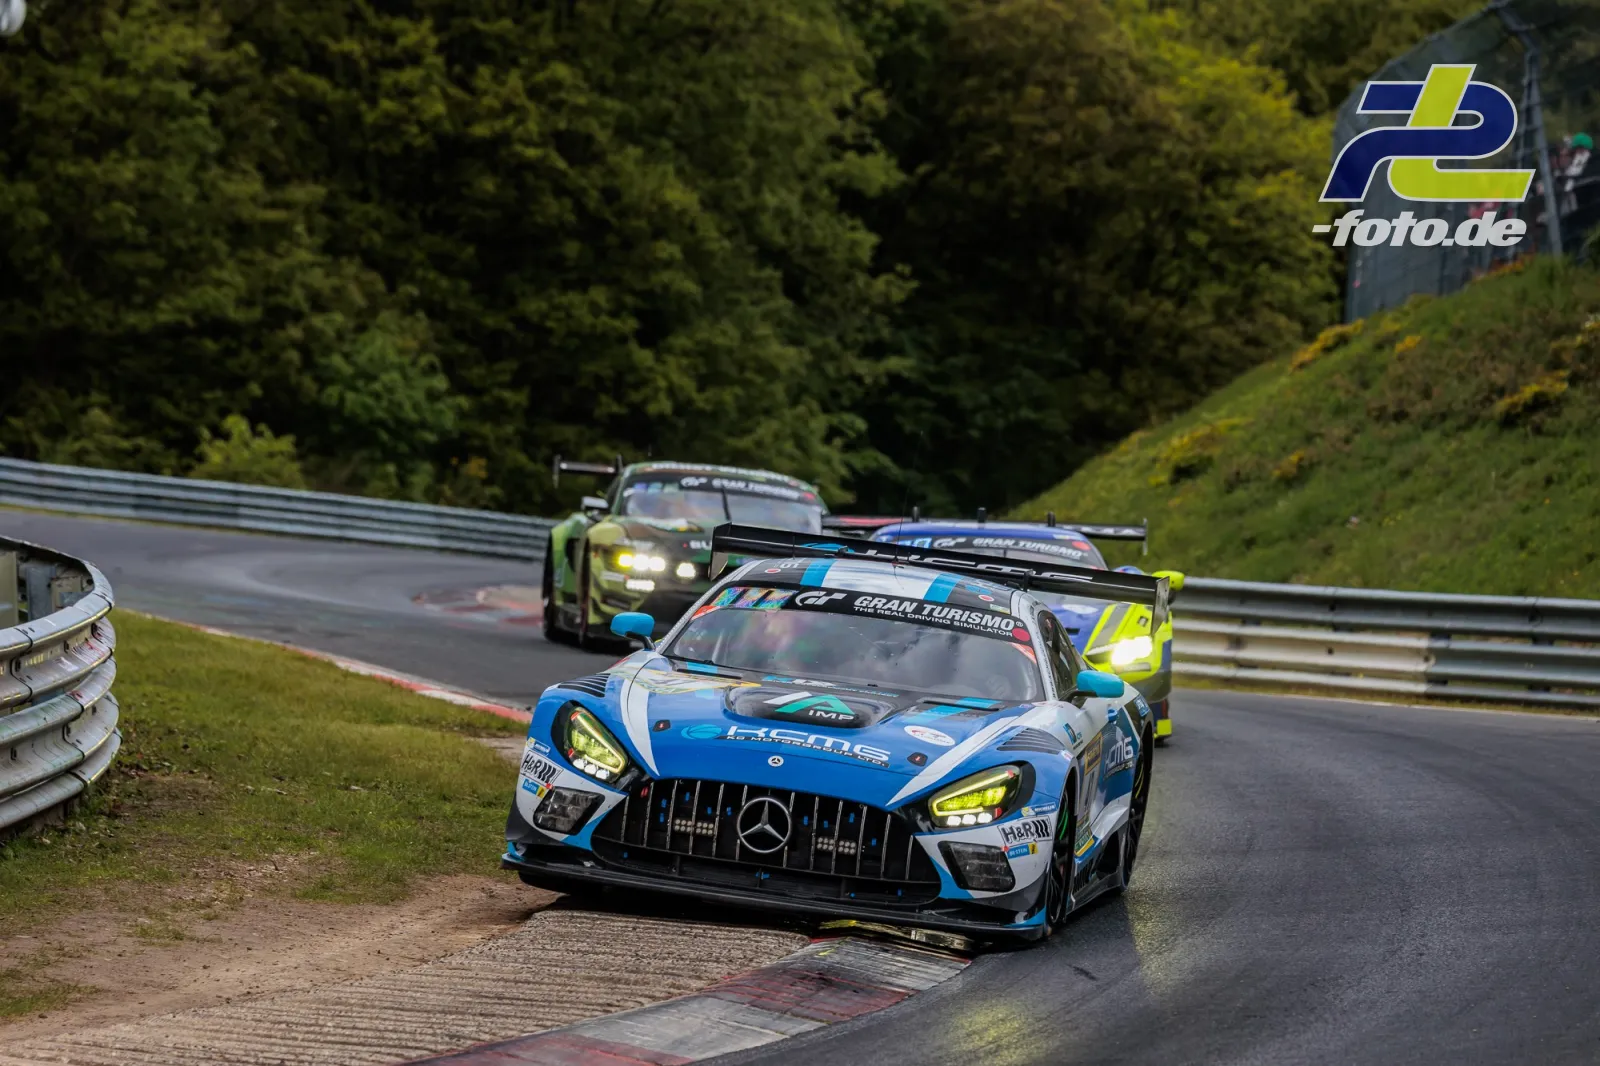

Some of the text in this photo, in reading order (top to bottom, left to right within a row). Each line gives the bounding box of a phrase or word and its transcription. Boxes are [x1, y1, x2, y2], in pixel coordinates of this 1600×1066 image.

[972, 537, 1014, 548] GRAN
[853, 595, 914, 613] GRAN
[877, 609, 905, 617] REAL
[907, 613, 950, 625] DRIVING
[953, 620, 1013, 637] SIMULATOR
[808, 709, 855, 720] IMP
[751, 736, 853, 756] MOTORGROUP
[522, 754, 542, 775] H&R
[1001, 821, 1035, 842] H&R
